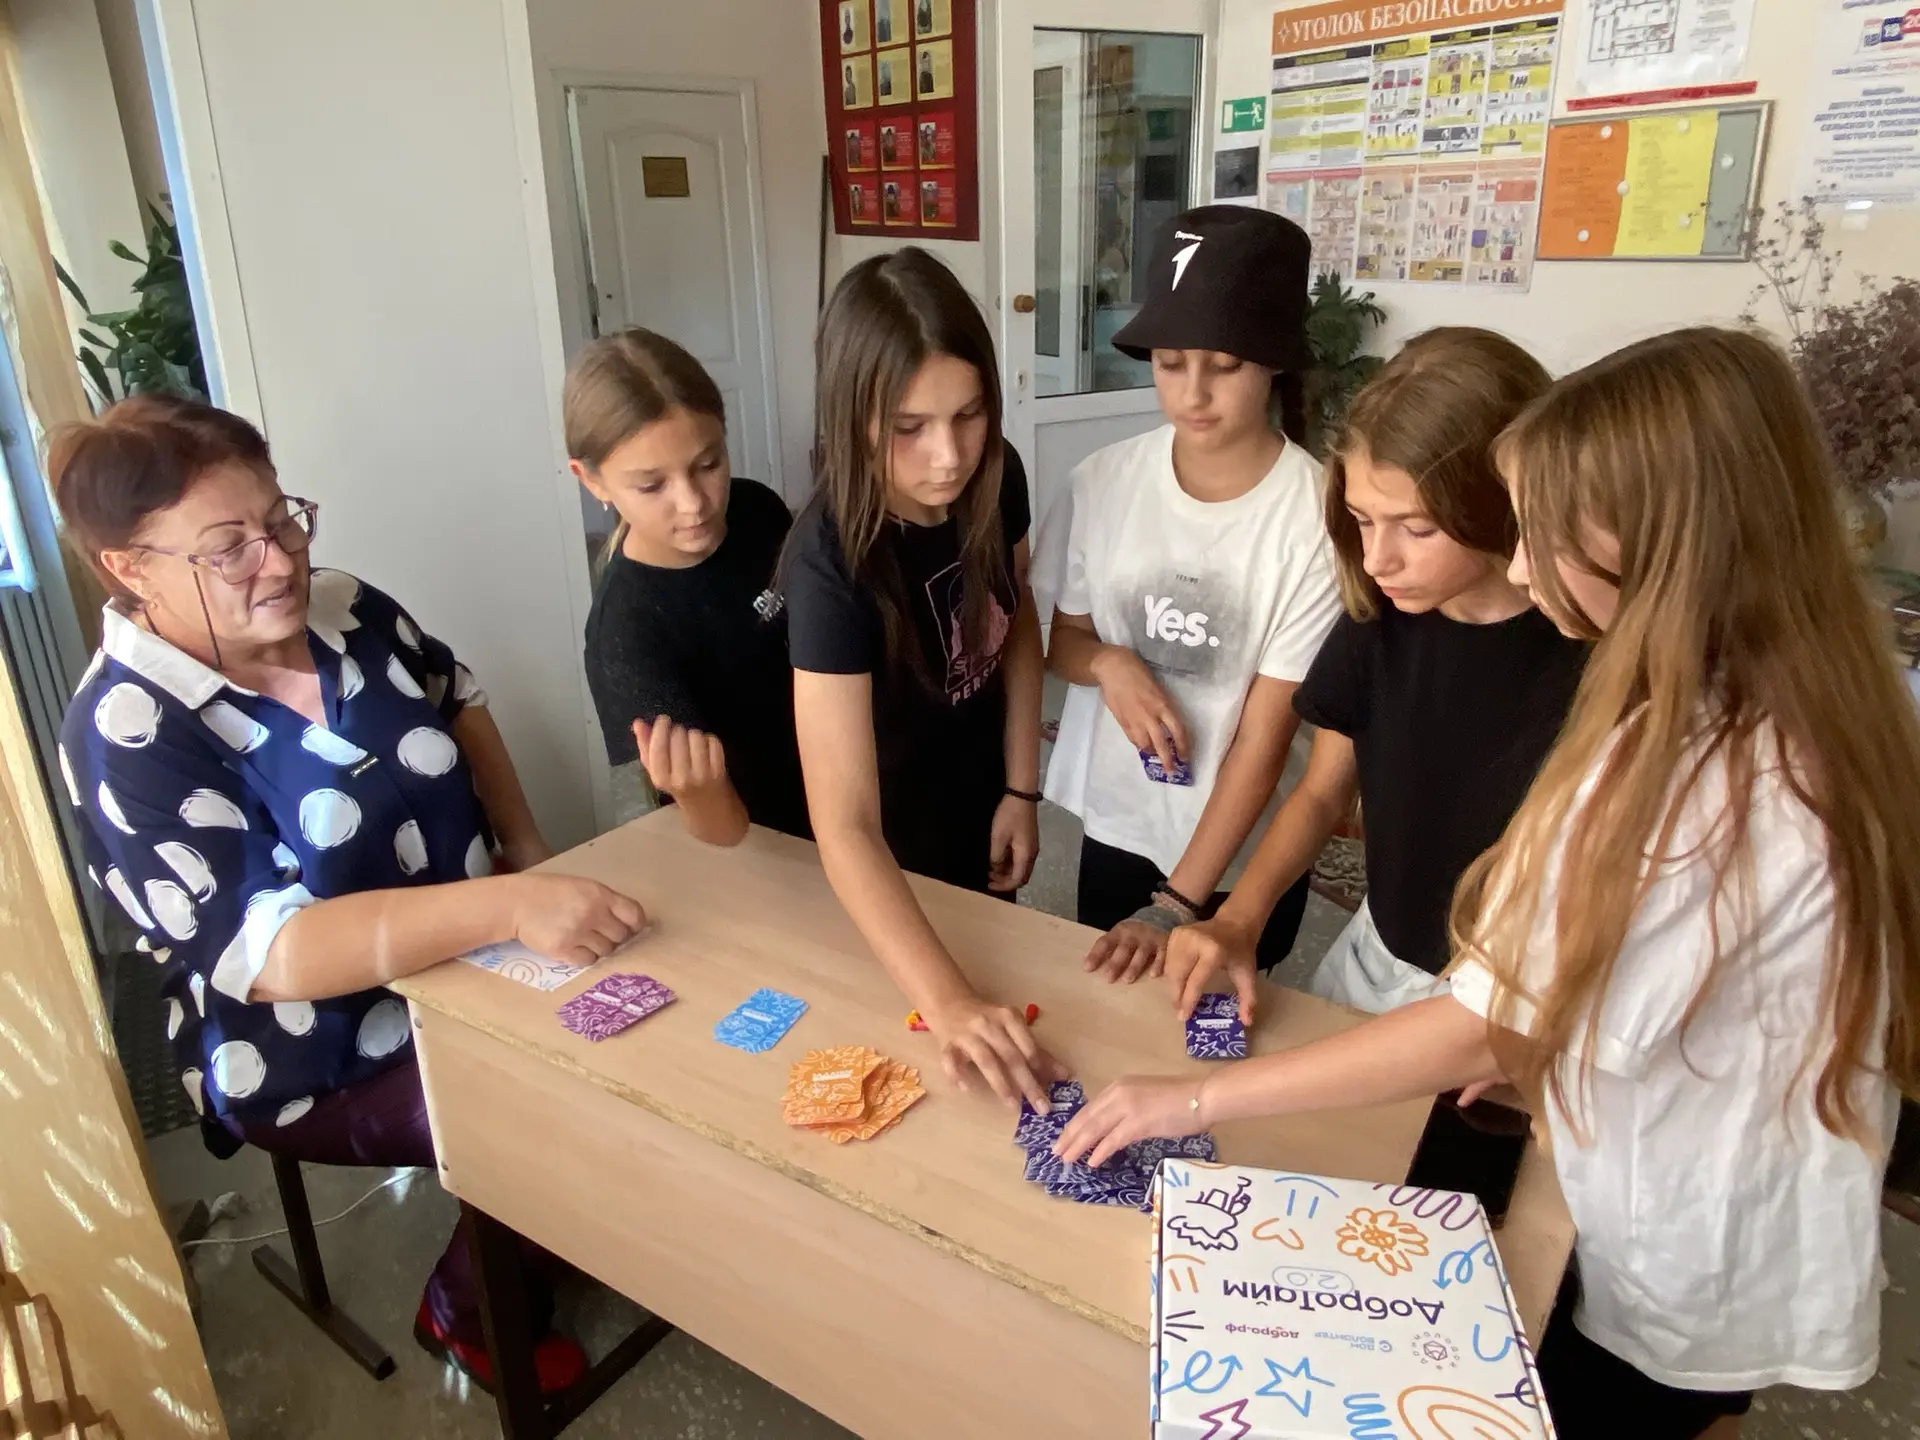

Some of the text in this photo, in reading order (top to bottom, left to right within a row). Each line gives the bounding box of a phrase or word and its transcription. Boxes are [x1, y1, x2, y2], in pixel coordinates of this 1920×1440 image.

[1292, 15, 1365, 43] УГОЛОК
[1371, 0, 1554, 30] БЕЗОПАСНО
[1144, 594, 1220, 647] Yes.
[1223, 1279, 1445, 1326] ДоброТайм
[1225, 1322, 1300, 1340] добро.рф
